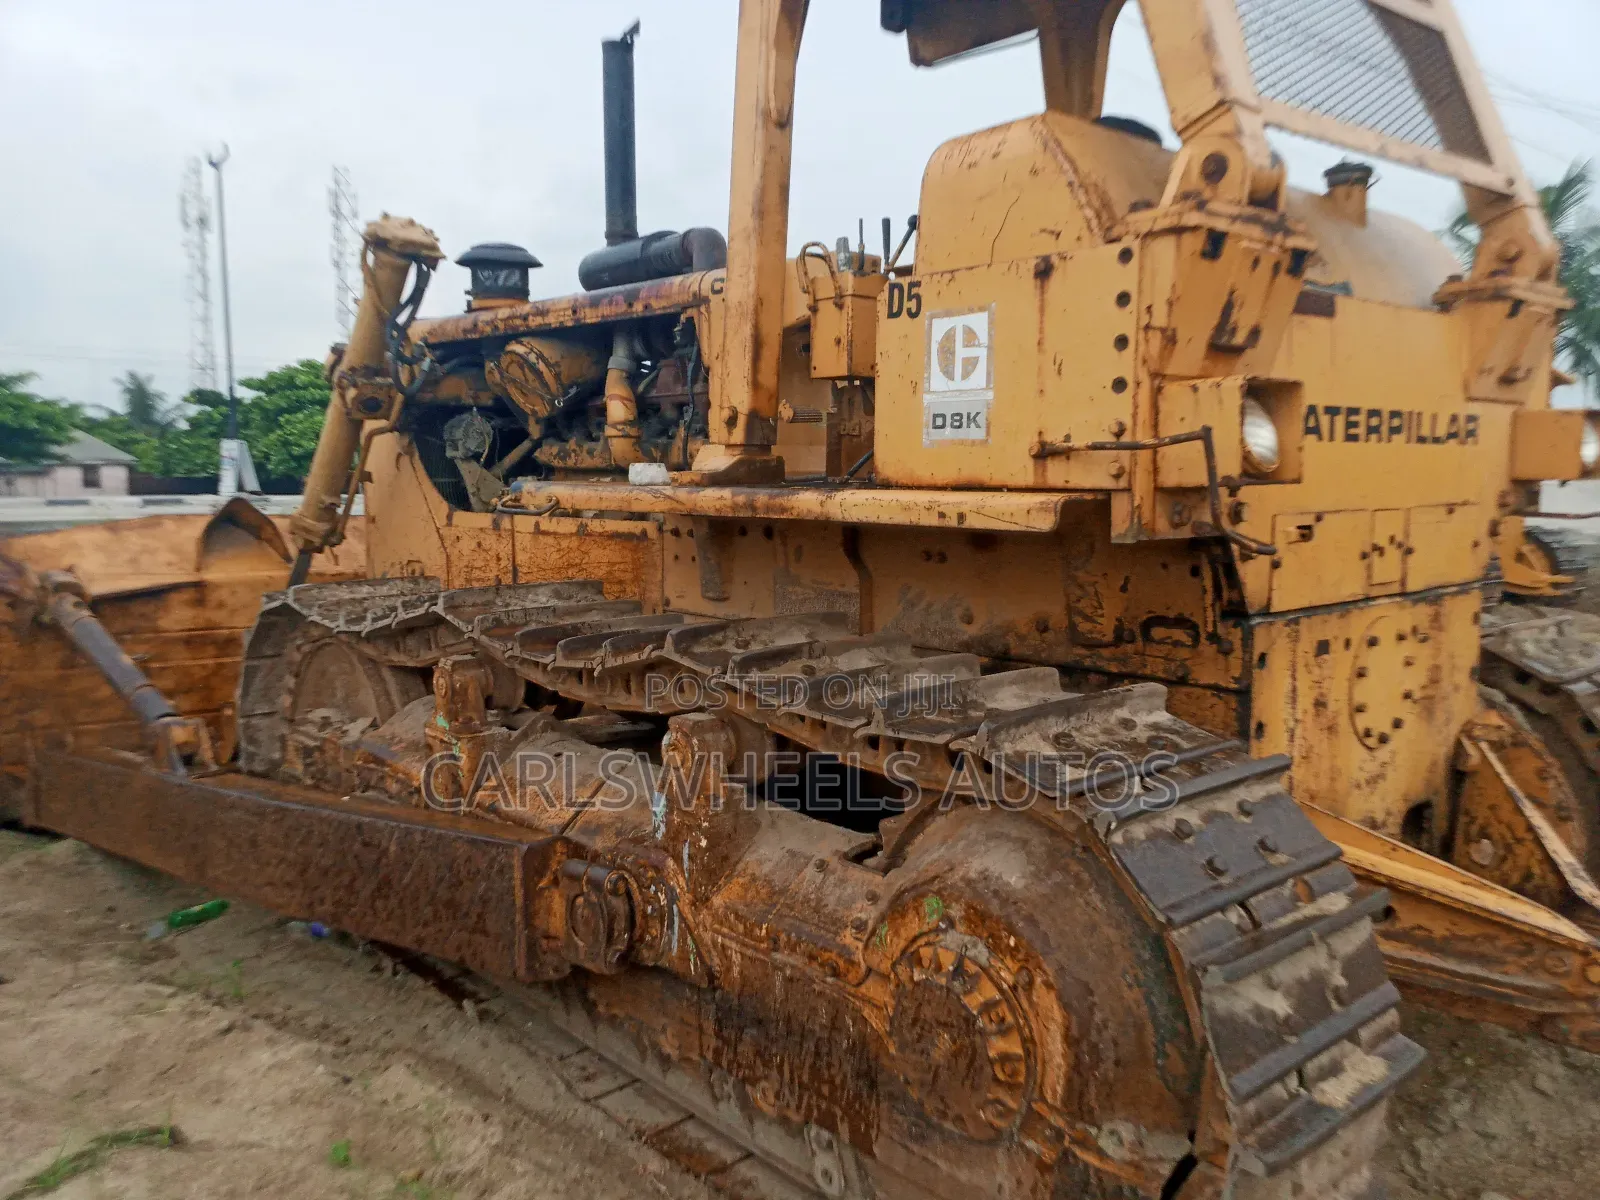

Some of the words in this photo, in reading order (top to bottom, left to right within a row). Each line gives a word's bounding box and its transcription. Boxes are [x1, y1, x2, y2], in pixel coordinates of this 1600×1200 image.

[887, 281, 922, 319] D5
[932, 412, 982, 429] D8K
[1303, 404, 1480, 445] ATERPILLAR
